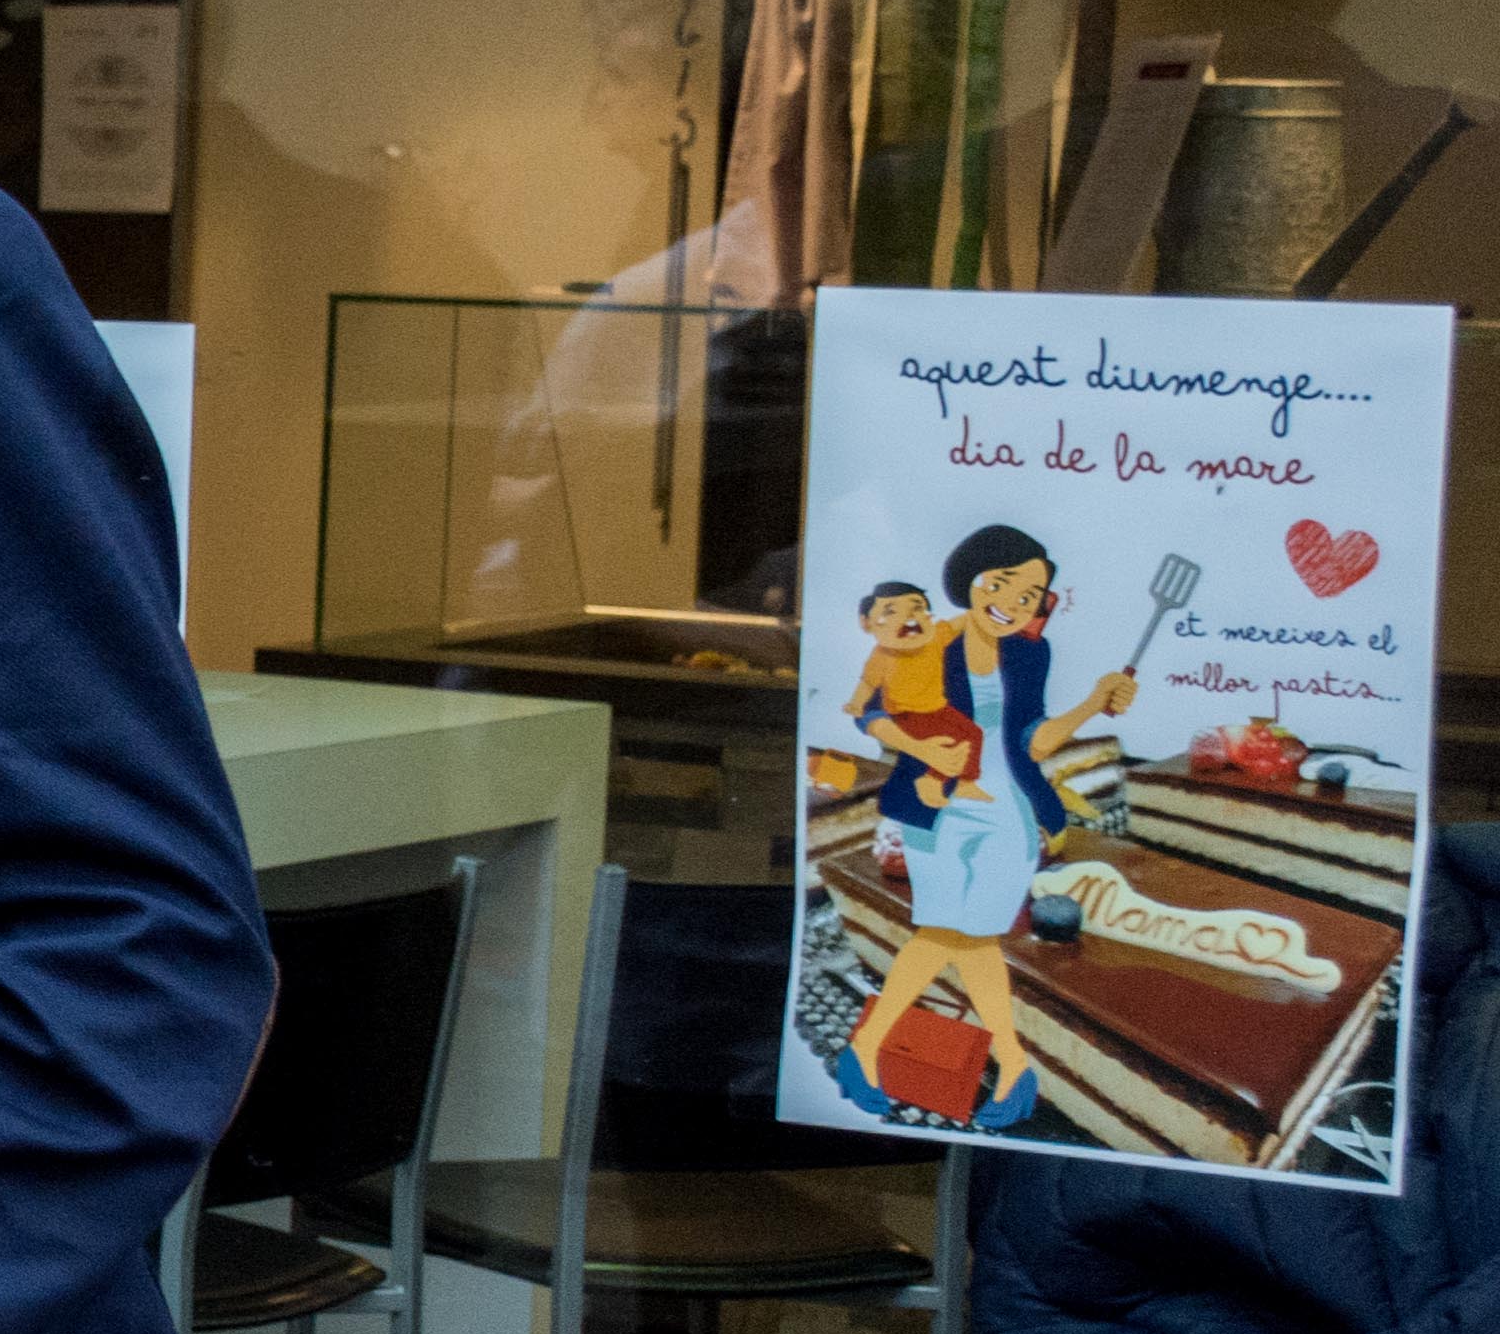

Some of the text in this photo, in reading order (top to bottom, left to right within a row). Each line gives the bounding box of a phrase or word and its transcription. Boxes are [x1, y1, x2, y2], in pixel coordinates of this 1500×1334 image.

[900, 345, 1066, 418] aquest
[949, 415, 1316, 486] dia de la mare
[1174, 611, 1399, 655] et mereixes el
[1165, 662, 1260, 693] millor
